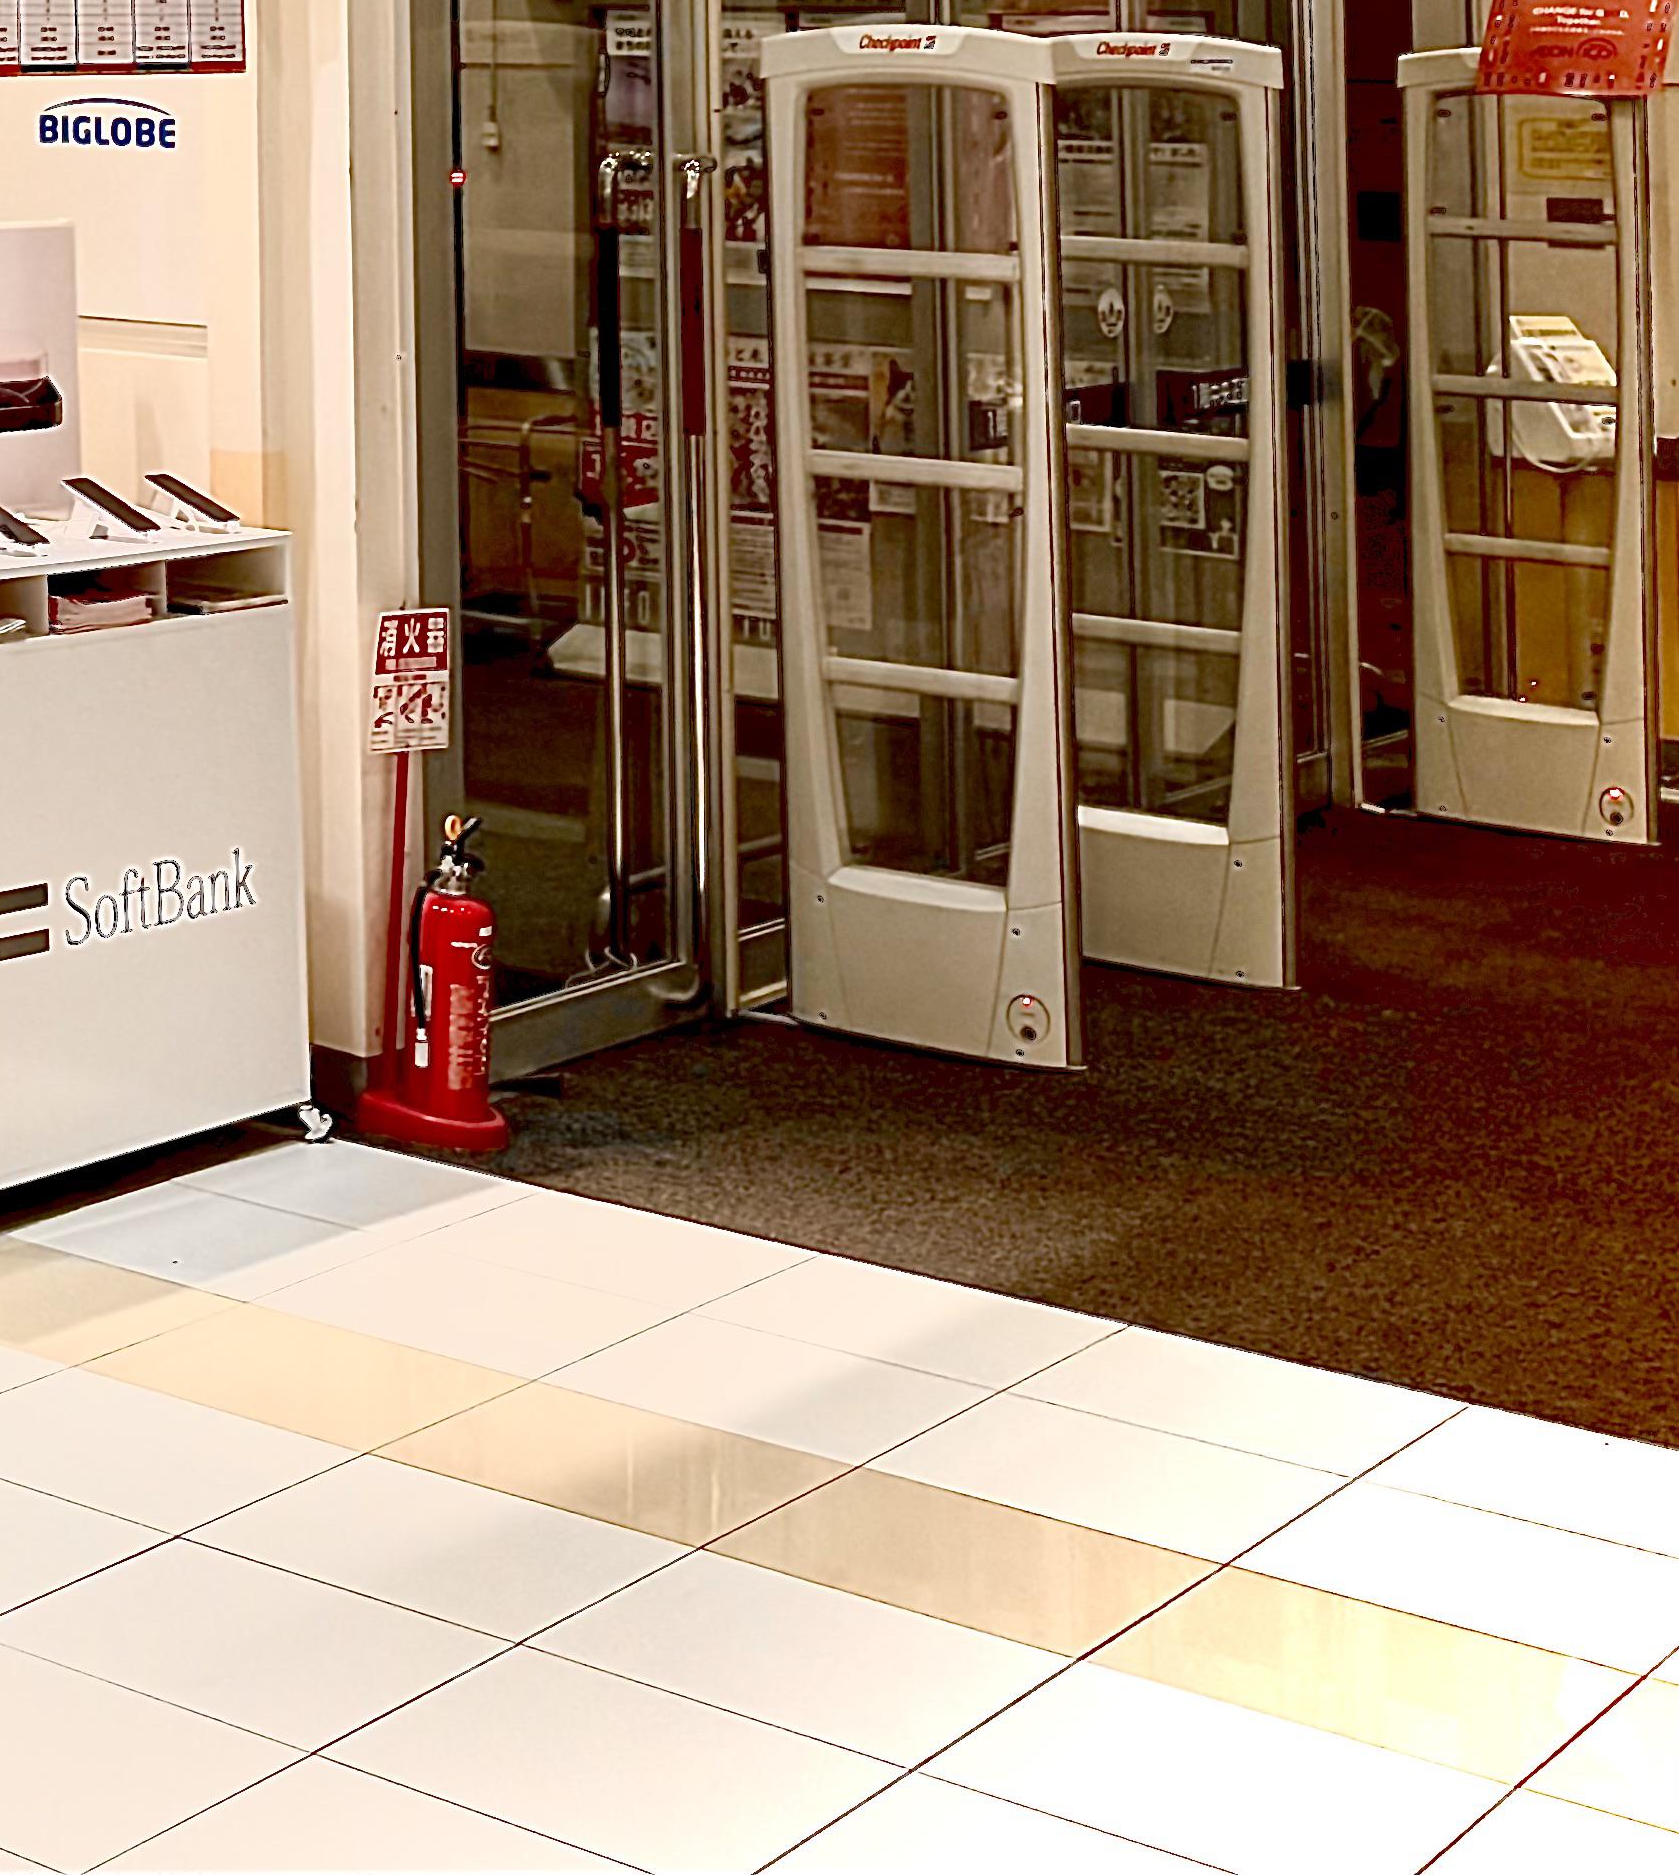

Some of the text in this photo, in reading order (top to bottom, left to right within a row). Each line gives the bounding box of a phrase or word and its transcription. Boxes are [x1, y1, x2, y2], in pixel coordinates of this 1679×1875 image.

[858, 34, 922, 52] Checkpoint
[1096, 40, 1156, 58] Checkpoint
[40, 115, 176, 148] BIGLOBE
[66, 847, 257, 947] SoftBank
